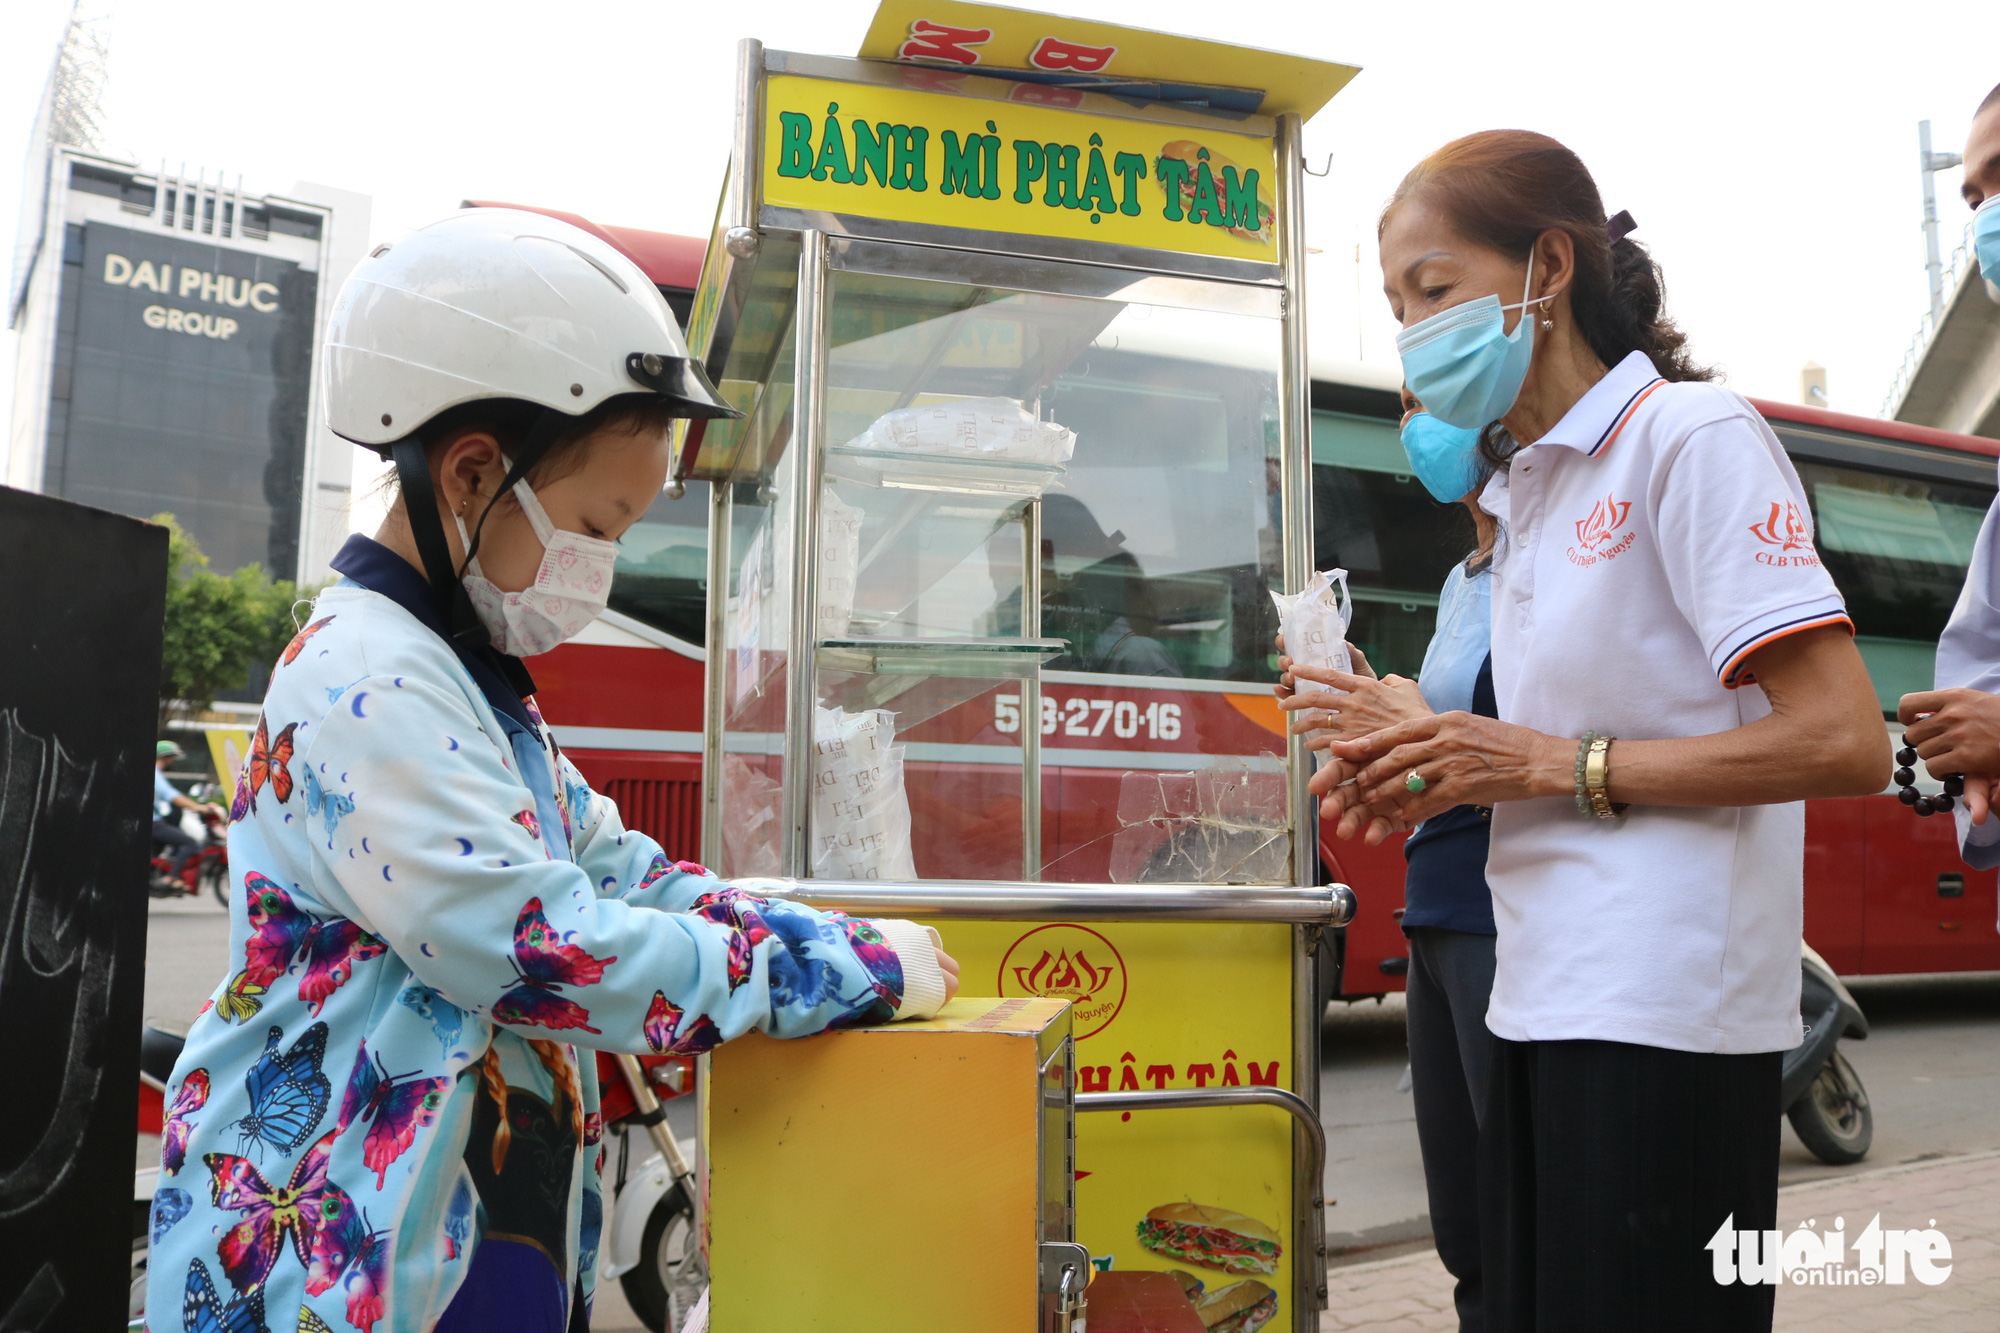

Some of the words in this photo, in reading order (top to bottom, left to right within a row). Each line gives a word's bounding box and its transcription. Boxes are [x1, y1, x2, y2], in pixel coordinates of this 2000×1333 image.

[777, 102, 929, 192] BÁNH
[939, 120, 1001, 200] MÌ
[1013, 132, 1147, 224] PHẬT
[1157, 147, 1260, 231] TÂM
[104, 253, 172, 295] DAI
[178, 267, 280, 313] PHUC
[143, 305, 239, 340] GROUP
[963, 412, 978, 450] DELI
[1598, 531, 1636, 562] Nguyện
[1755, 551, 1788, 567] CLB
[817, 737, 846, 756] ELI
[850, 766, 880, 788] DEL
[821, 831, 854, 850] DEL
[1074, 1002, 1115, 1021] Nguyện
[1187, 1049, 1280, 1088] TÂM
